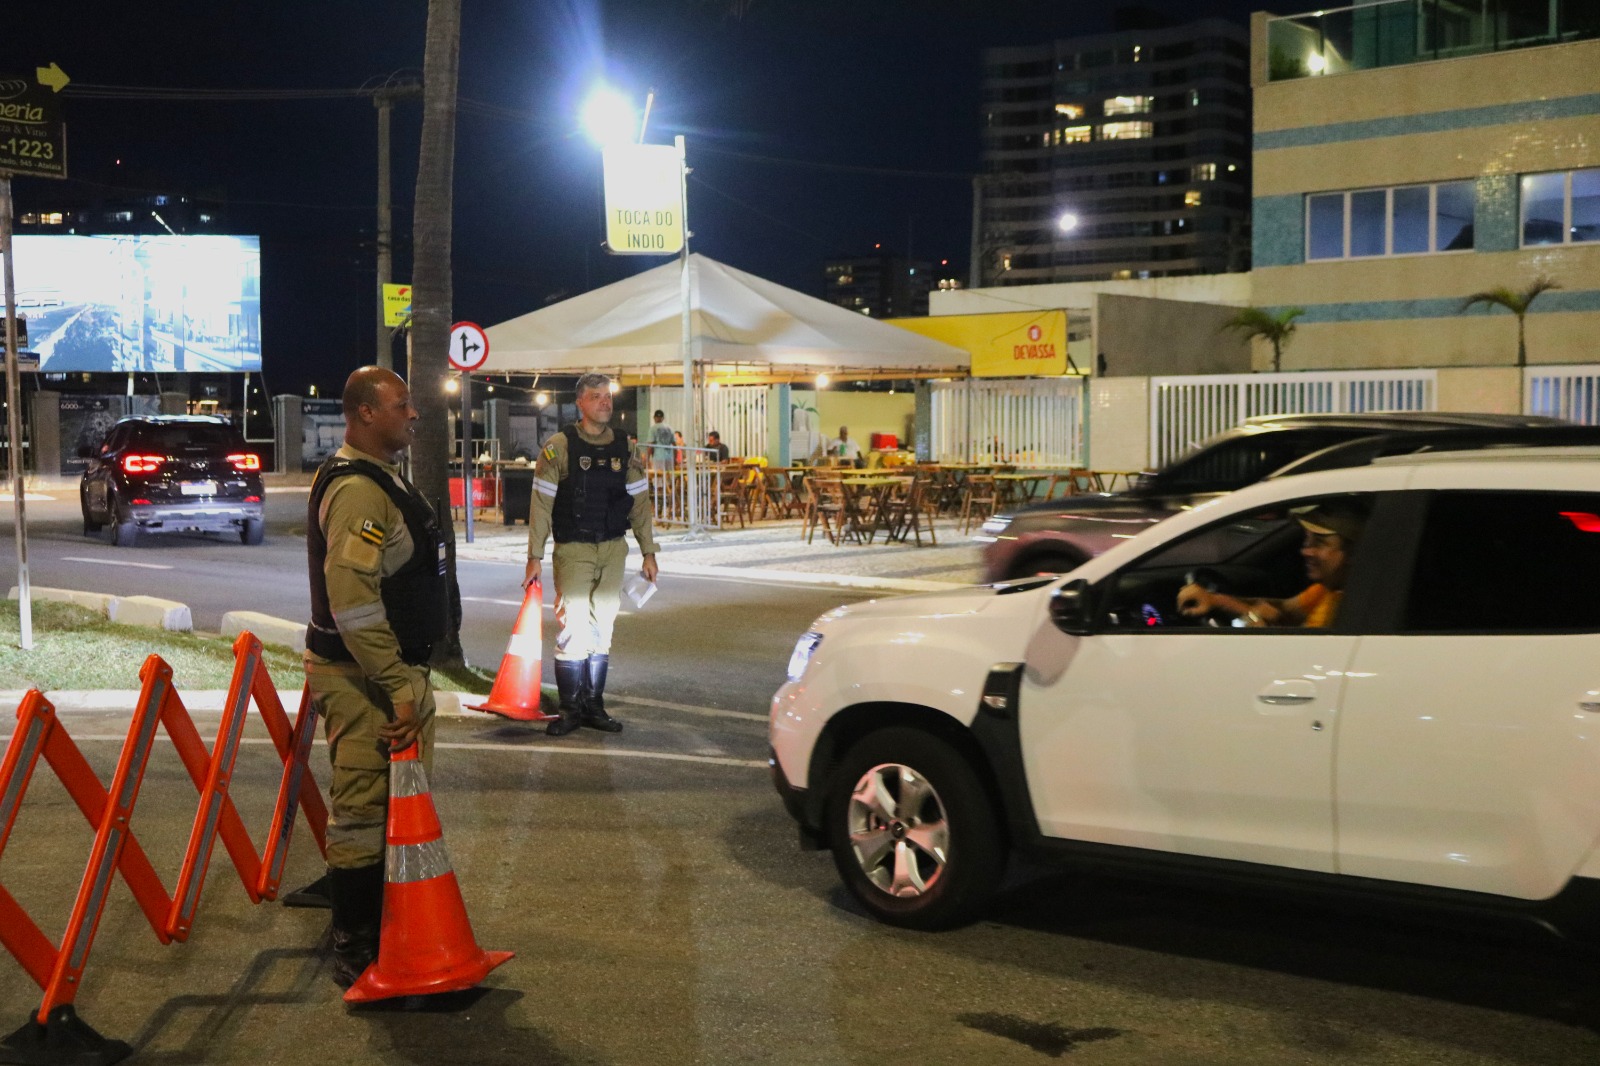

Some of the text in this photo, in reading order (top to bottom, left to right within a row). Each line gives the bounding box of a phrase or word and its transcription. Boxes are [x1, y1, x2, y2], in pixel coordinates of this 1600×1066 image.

[617, 210, 673, 226] TOCA DO
[1014, 344, 1056, 360] DEVASSA
